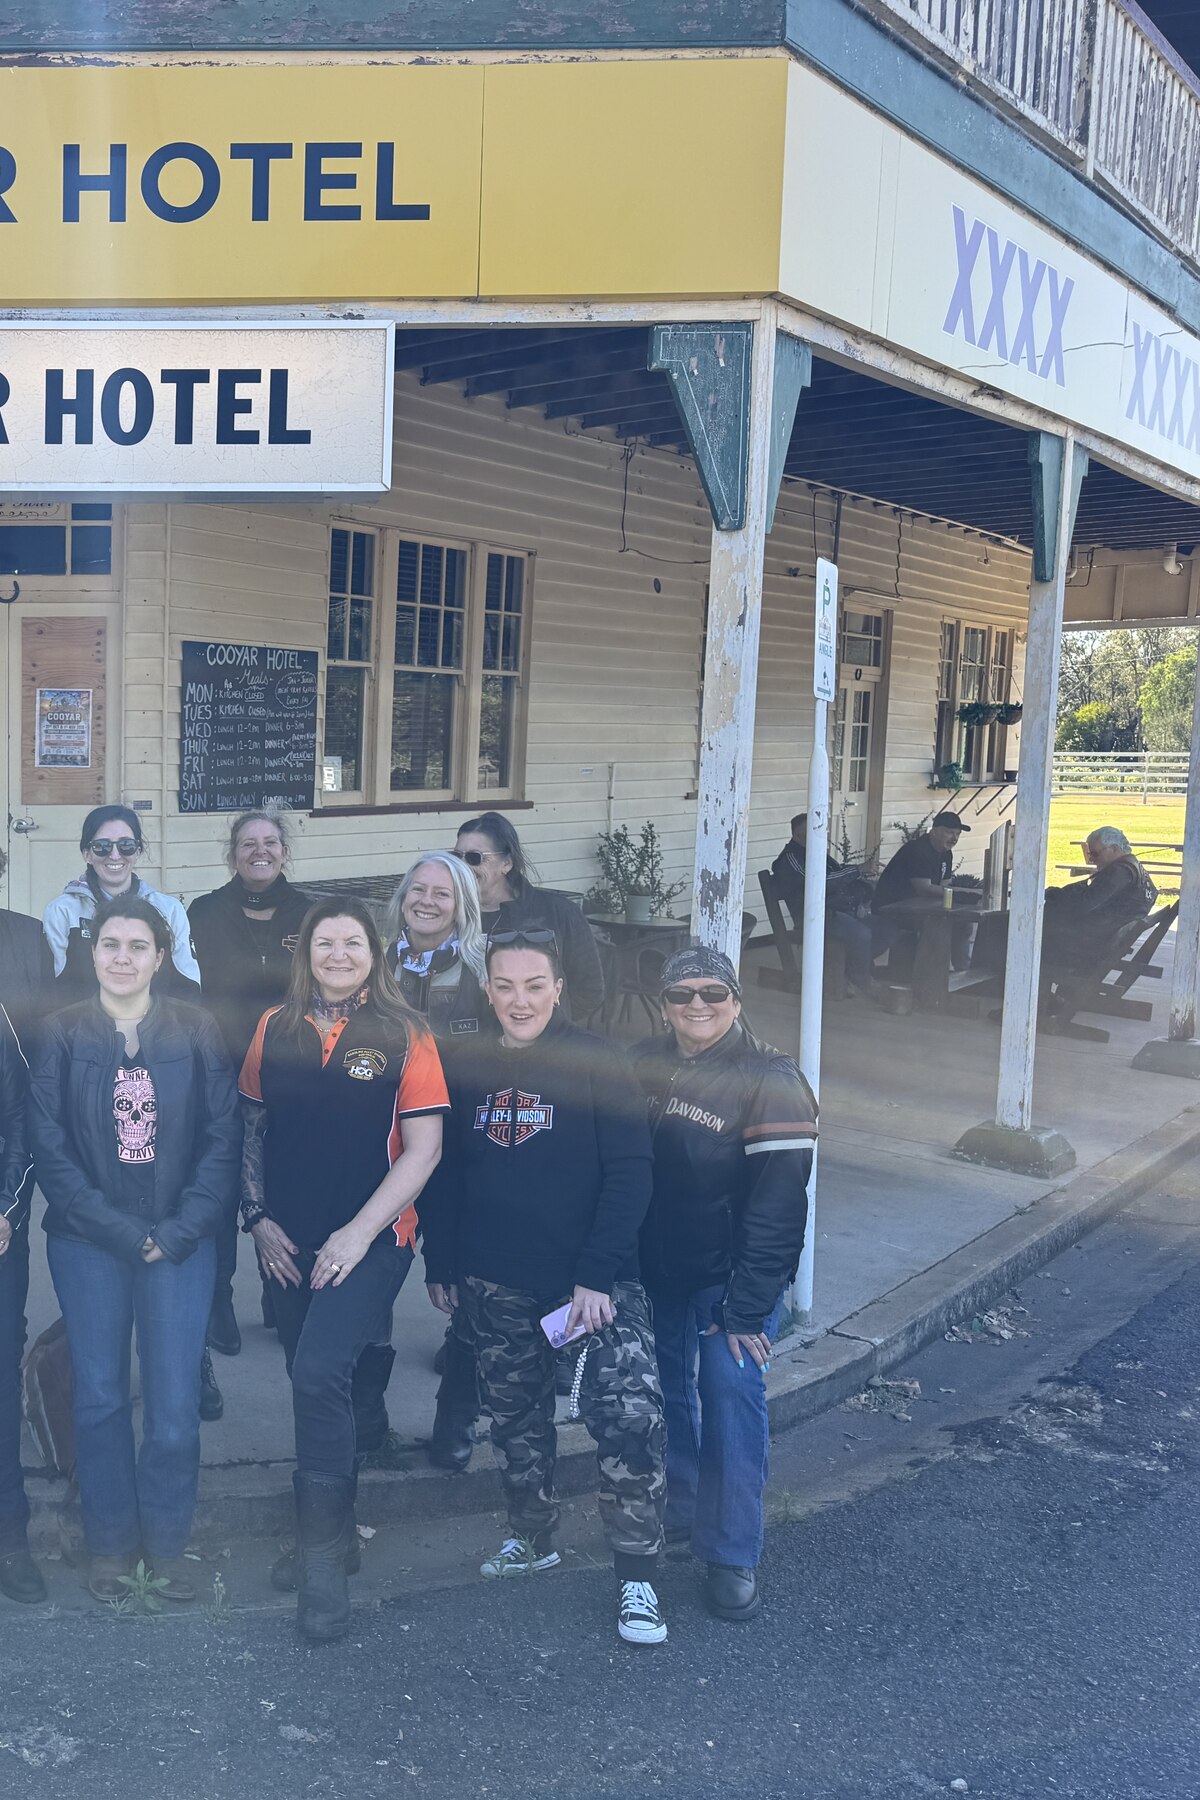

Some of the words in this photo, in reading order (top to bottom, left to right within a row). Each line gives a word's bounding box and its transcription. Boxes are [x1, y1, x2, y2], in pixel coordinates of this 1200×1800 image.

[63, 142, 430, 223] HOTEL
[942, 202, 1075, 390] XXXX
[45, 368, 311, 445] HOTEL
[206, 644, 258, 666] COOYAR
[266, 649, 303, 670] HOTEL
[818, 642, 833, 658] ANGLE
[186, 682, 213, 702] MON
[47, 712, 81, 721] COOYAR
[183, 703, 212, 720] TUES
[184, 722, 212, 738] WED
[182, 738, 209, 756] THUR
[183, 755, 204, 773] FRI
[182, 772, 206, 790] SAT
[181, 791, 206, 811] SUN
[665, 1097, 725, 1132] DAVIDSON
